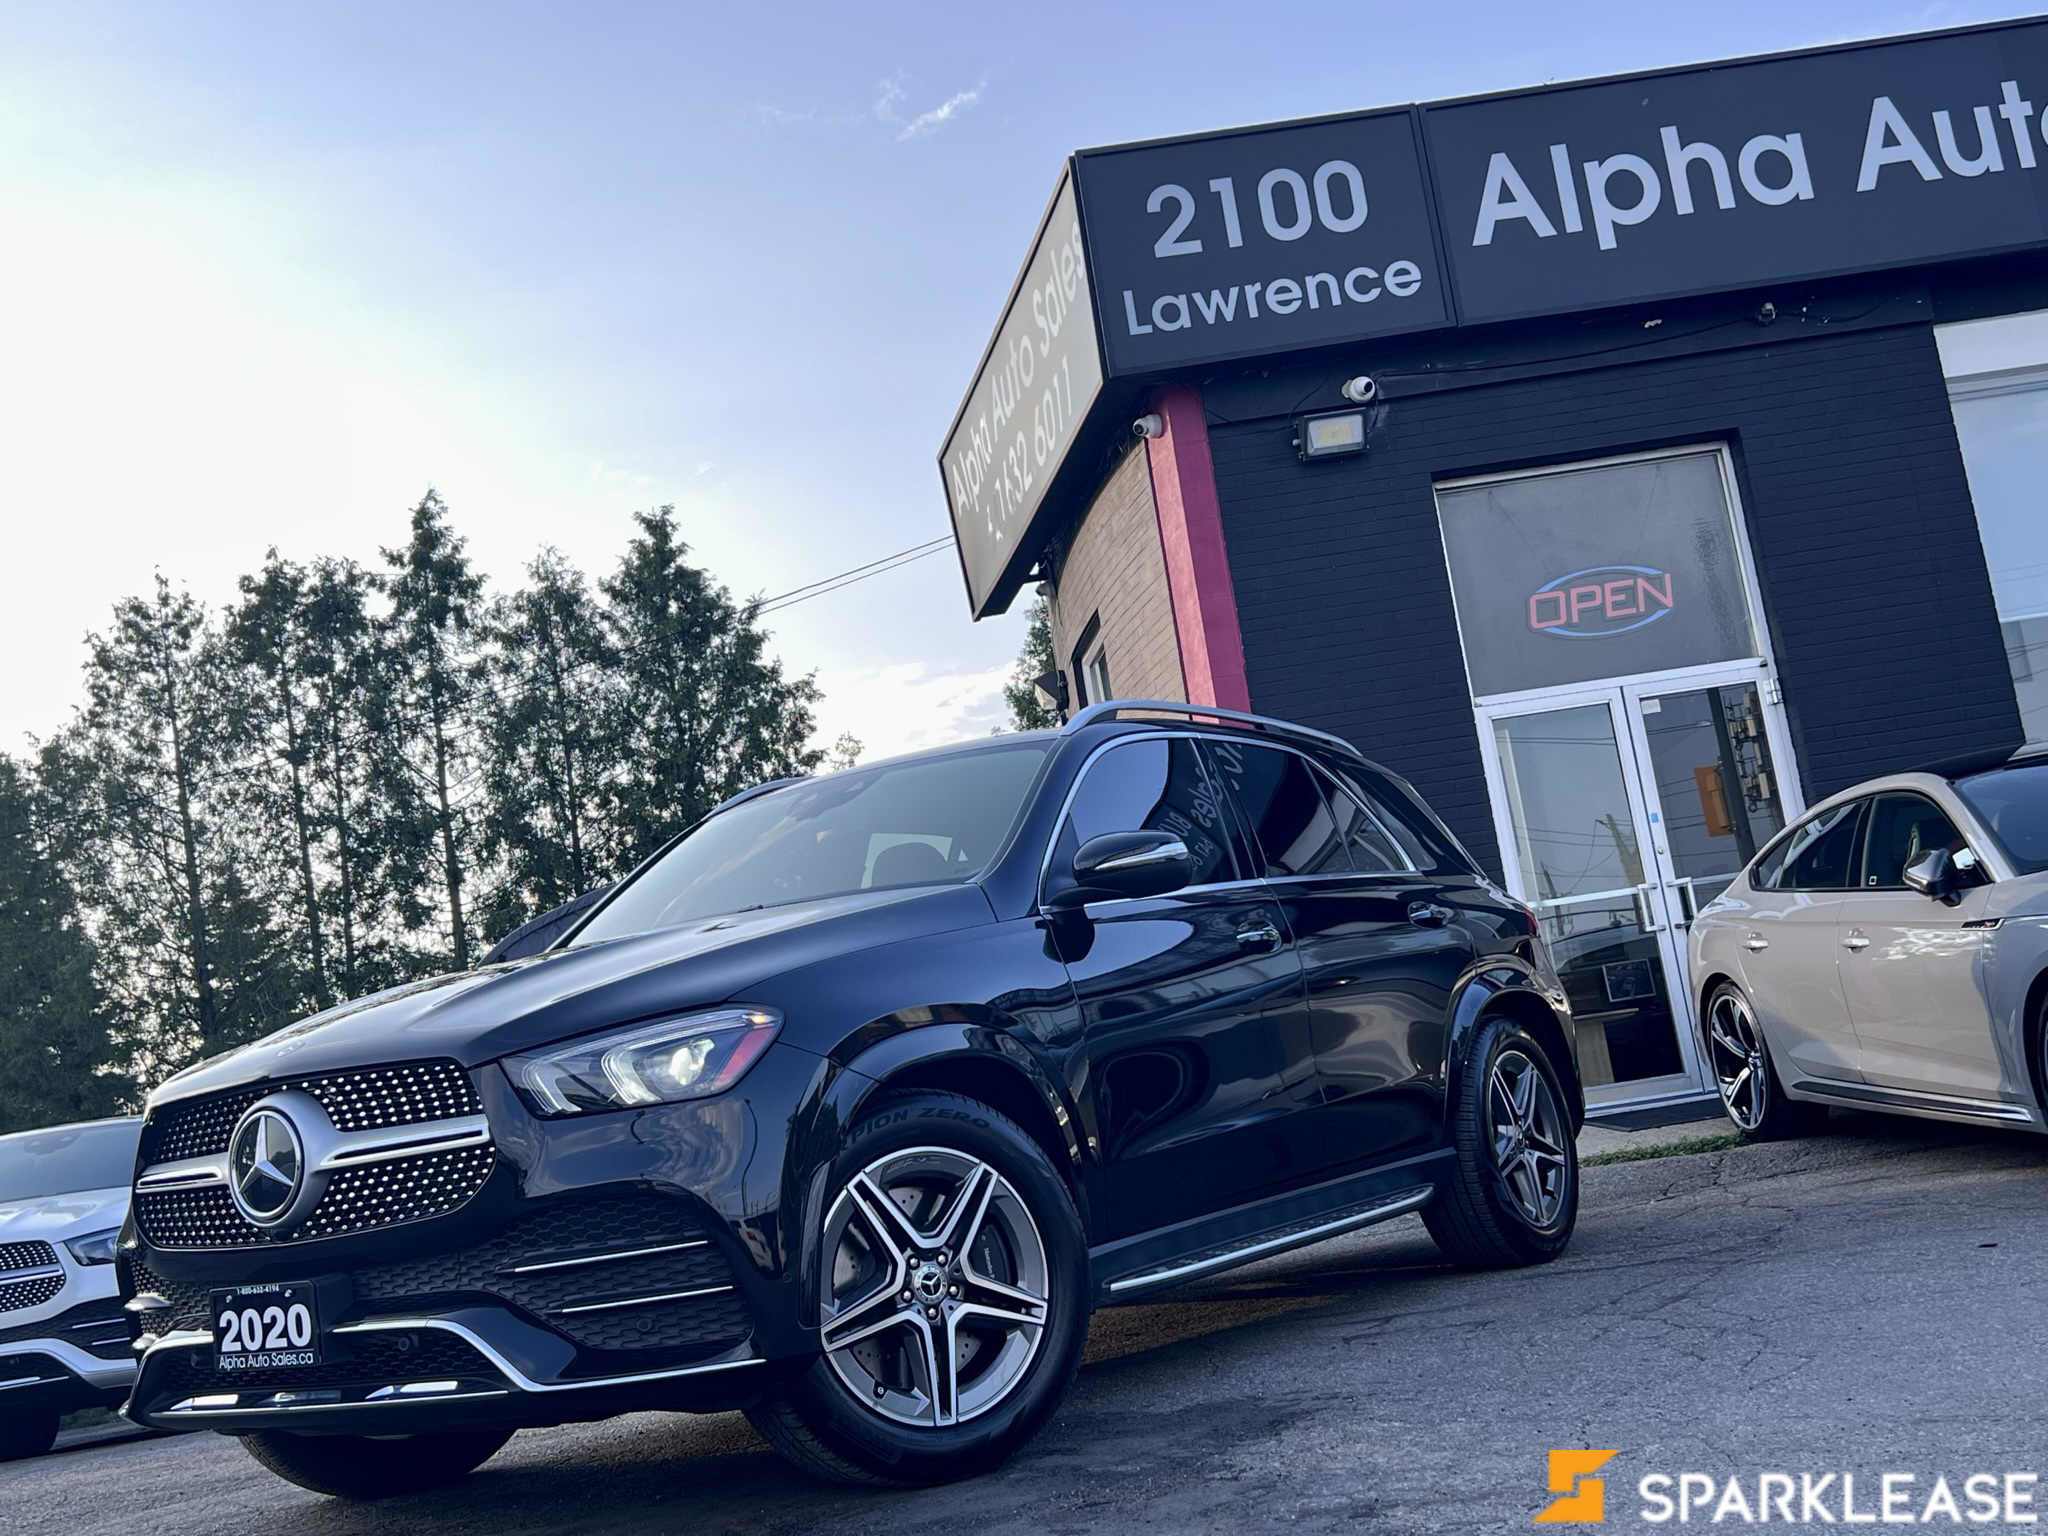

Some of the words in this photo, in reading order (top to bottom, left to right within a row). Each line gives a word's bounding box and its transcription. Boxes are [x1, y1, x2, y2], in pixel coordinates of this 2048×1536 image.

[1473, 126, 1814, 250] Alpha
[1857, 81, 2048, 192] Aut
[1147, 160, 1368, 258] 2100
[1123, 259, 1422, 336] Lawrence
[952, 416, 992, 515] Alpha
[990, 336, 1034, 444] Auto
[1033, 222, 1085, 358] Sales
[1034, 355, 1072, 467] 6011
[1528, 573, 1674, 629] OPEN
[918, 1107, 991, 1129] ZERO
[219, 1303, 312, 1352] 2020
[219, 1354, 246, 1372] Alpha
[247, 1353, 270, 1368] Auto
[271, 1351, 314, 1367] Sales.ca
